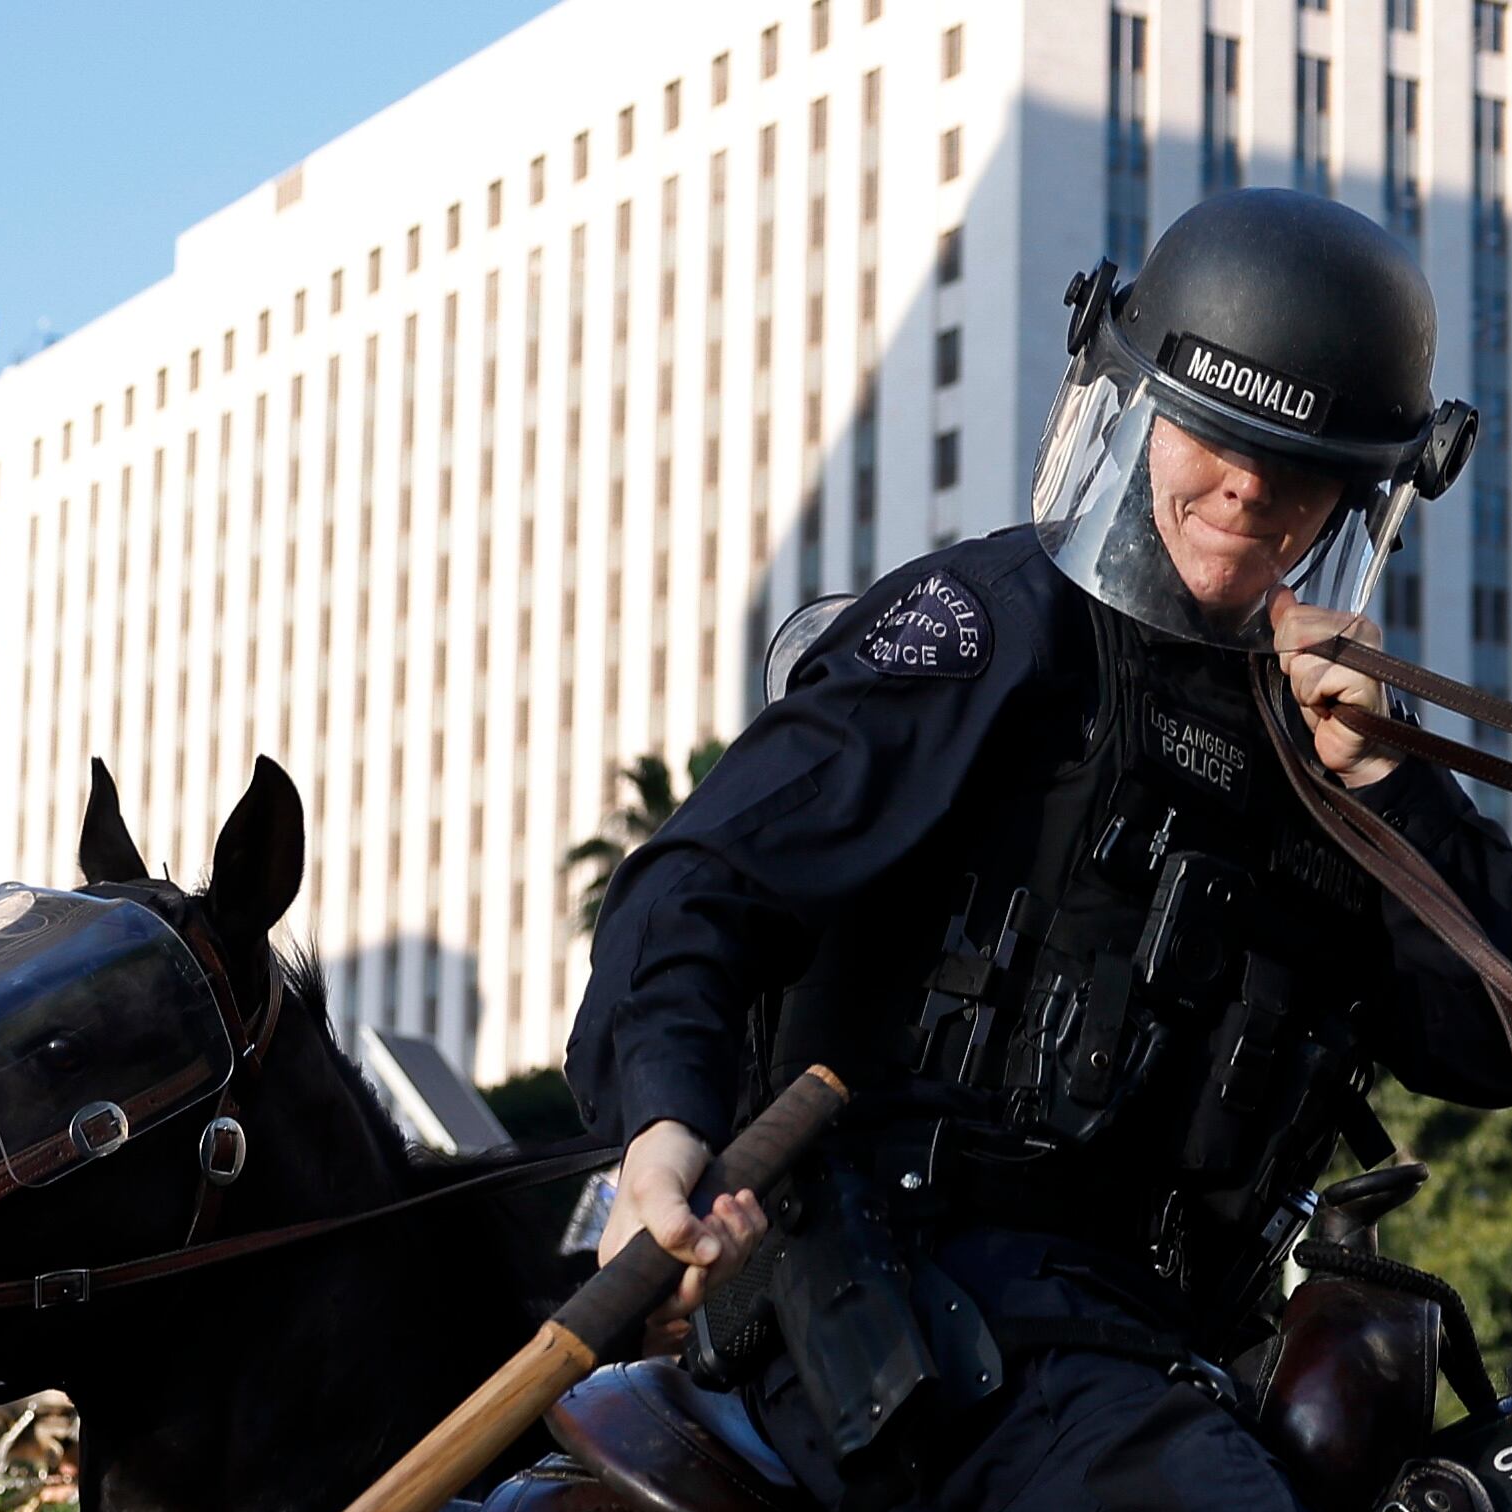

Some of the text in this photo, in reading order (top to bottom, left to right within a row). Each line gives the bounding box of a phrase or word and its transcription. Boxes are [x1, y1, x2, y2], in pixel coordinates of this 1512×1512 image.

[1186, 347, 1316, 421] McDONALD
[907, 576, 978, 659] ANGELES
[869, 636, 937, 666] POLICE
[1149, 707, 1245, 770] LOS ANGELES
[1161, 737, 1233, 792] POLICE
